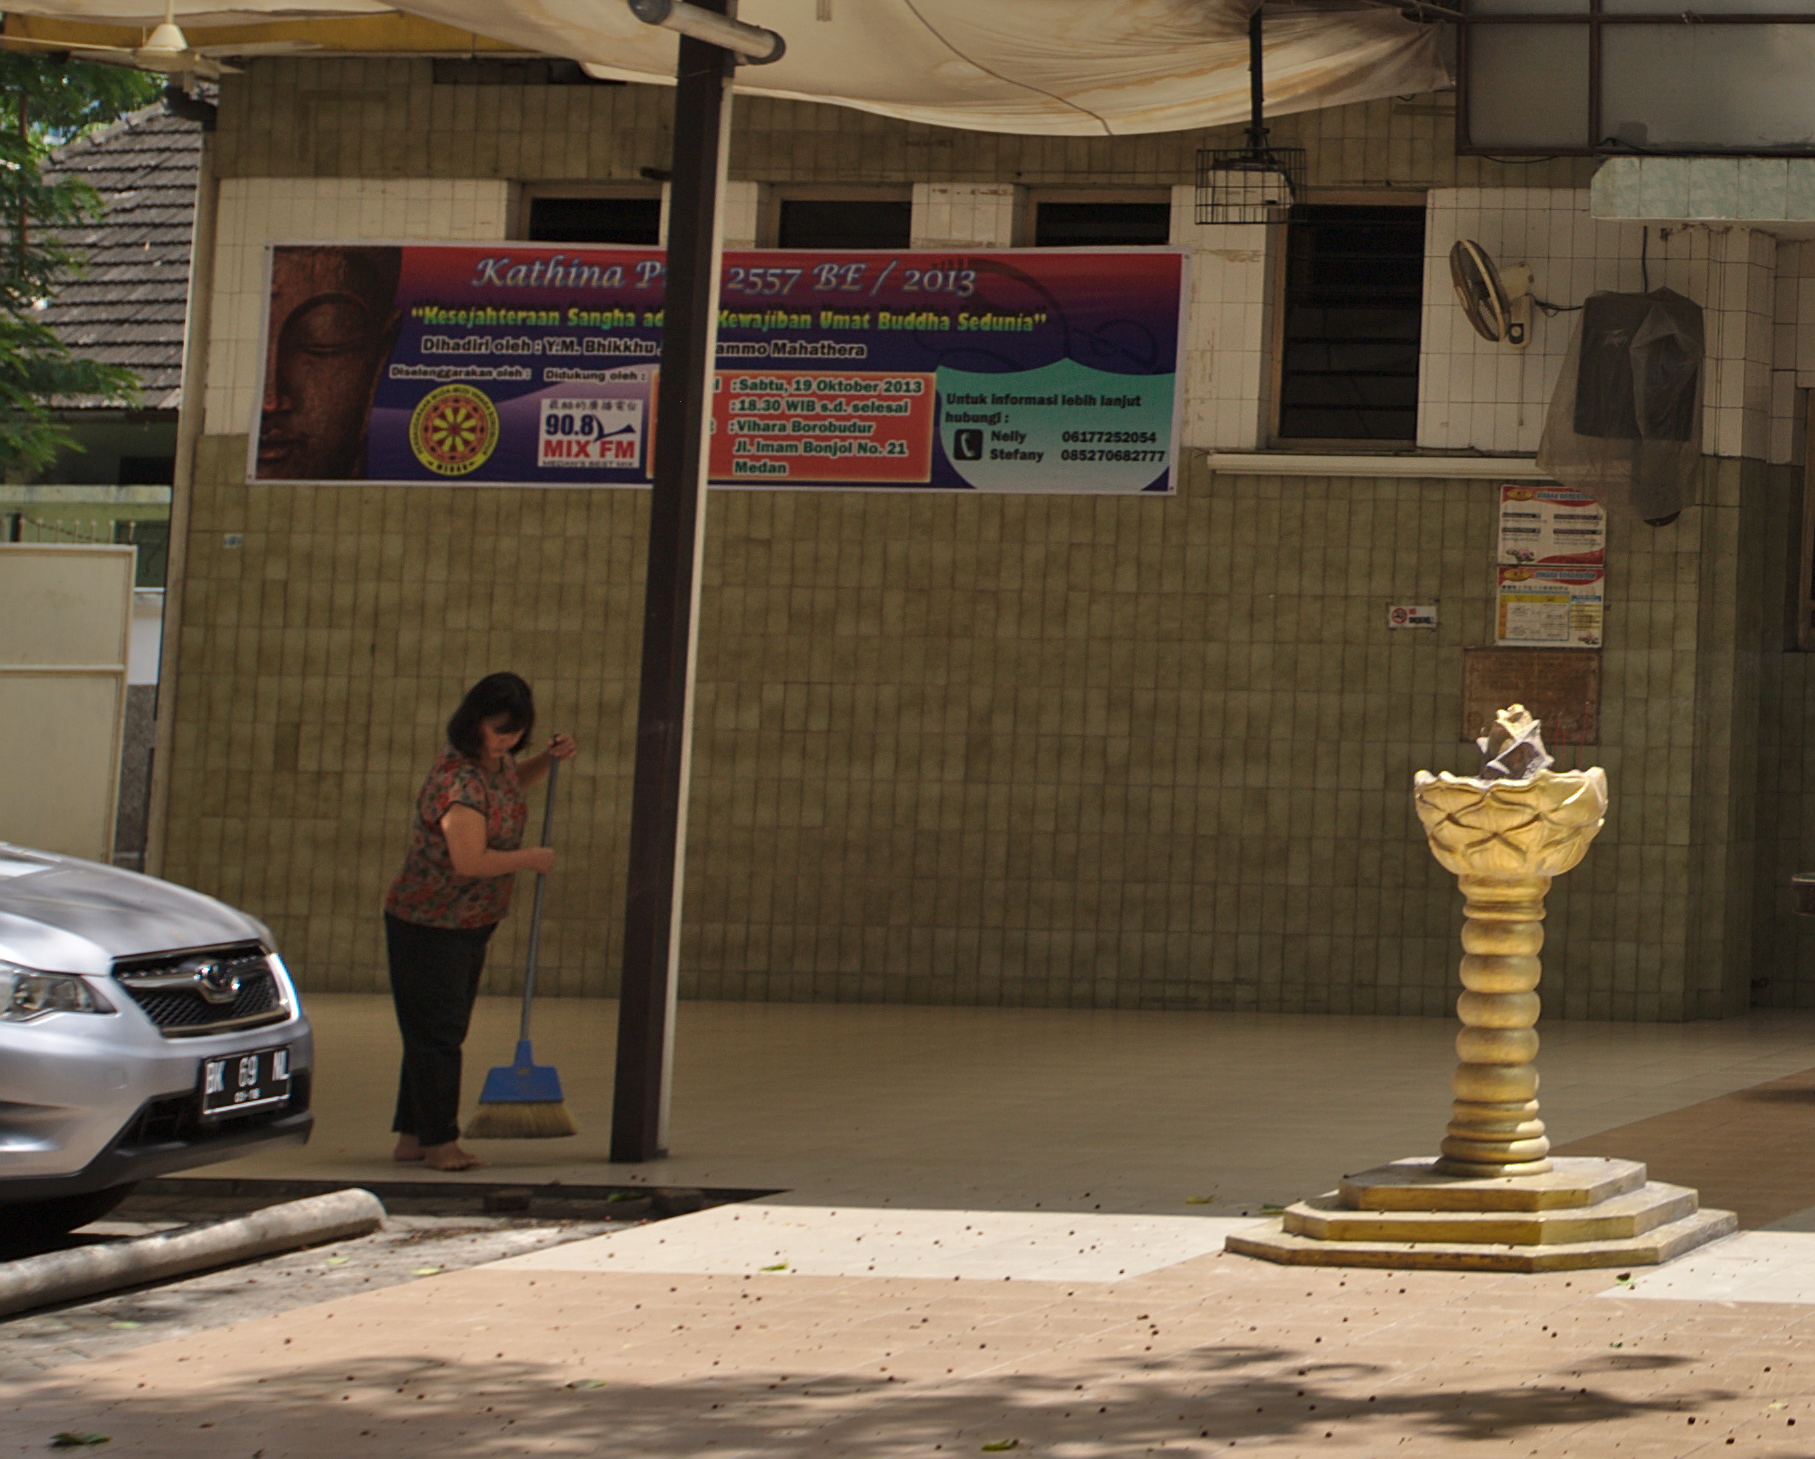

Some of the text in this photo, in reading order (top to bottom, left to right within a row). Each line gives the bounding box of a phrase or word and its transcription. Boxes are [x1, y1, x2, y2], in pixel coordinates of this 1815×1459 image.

[471, 255, 625, 289] Kathina
[726, 265, 804, 297] 2557
[812, 261, 868, 292] BE
[902, 267, 978, 299] 2013
[567, 307, 636, 331] Sangha
[718, 309, 812, 332] Kewajiban
[820, 310, 872, 330] Umat
[877, 310, 951, 332] Buddha
[421, 336, 490, 354] Dihadiri
[493, 337, 532, 354] oleh
[545, 337, 581, 354] Y.M.
[585, 337, 655, 355] Bhikkhu
[771, 342, 867, 359] Mahathera
[391, 365, 493, 379] Diselenggarakan
[496, 367, 523, 378] oleh
[545, 369, 606, 382] Didukung
[610, 371, 638, 381] oleh
[794, 380, 812, 391] 19
[817, 380, 879, 392] Oktober
[883, 381, 922, 393] 2013
[786, 400, 816, 412] WIB
[820, 400, 848, 413] s.d.
[852, 401, 909, 413] selesai
[946, 393, 1141, 409] Untuk informasi lebih lanjut
[545, 414, 594, 436] 90.8
[945, 412, 1001, 425] hubungi
[791, 420, 874, 434] Borobudur
[991, 431, 1157, 444] Nelly 06177252054
[543, 439, 635, 459] MIX FM
[734, 440, 906, 456] Jl. Imam Bonjol No. 21
[990, 448, 1165, 463] Stefany 085270682777
[734, 461, 787, 473] Medan
[204, 1060, 228, 1096] BK
[238, 1053, 259, 1088] 69
